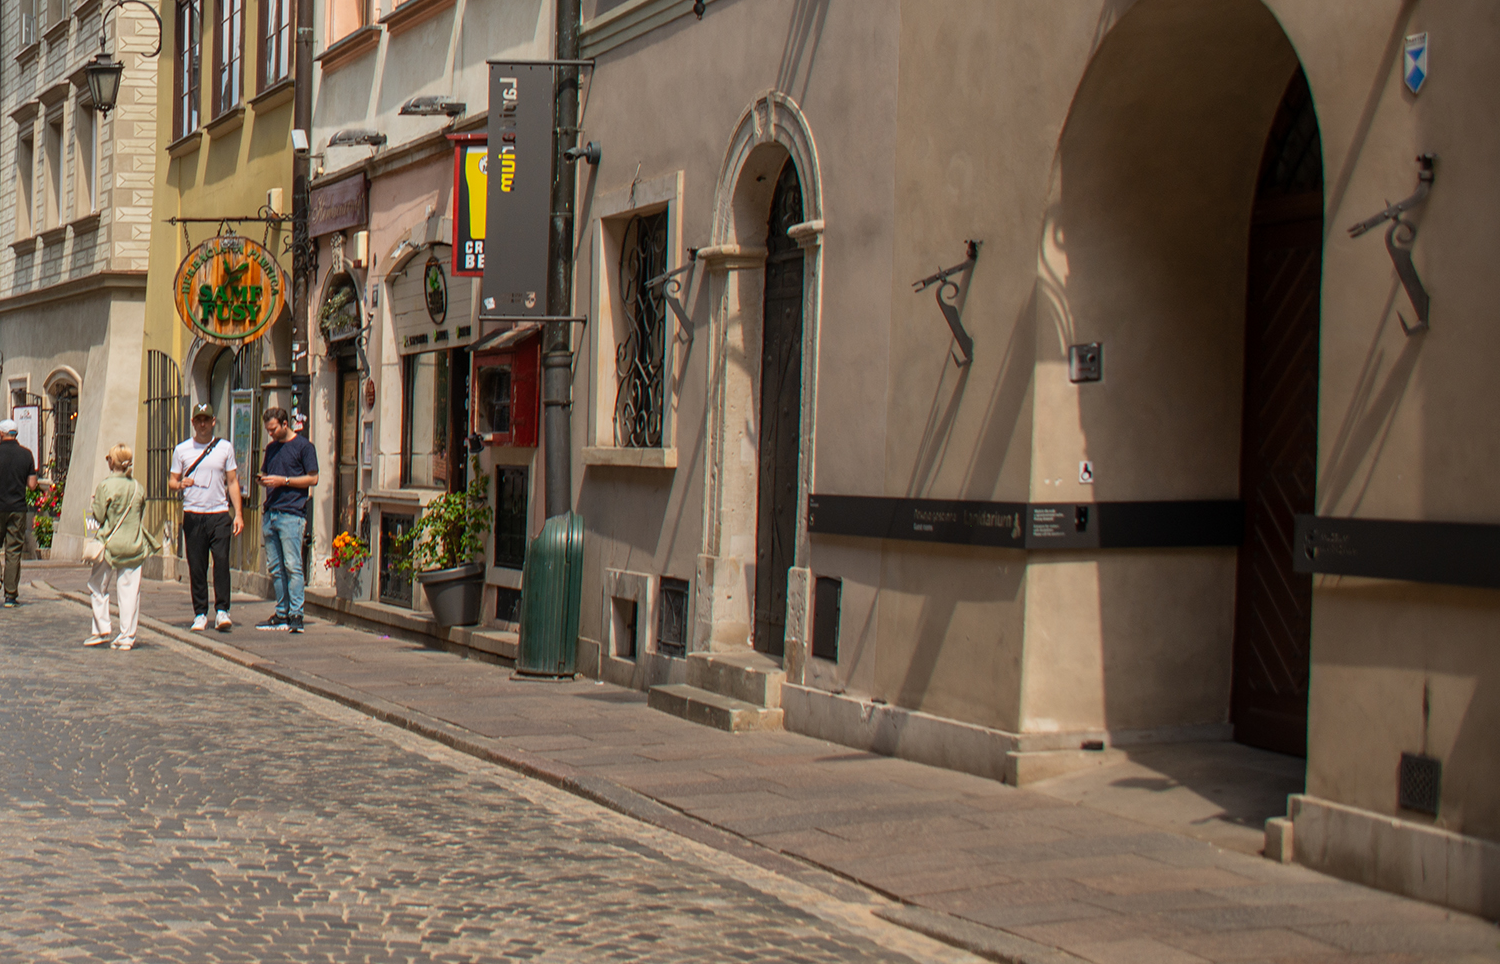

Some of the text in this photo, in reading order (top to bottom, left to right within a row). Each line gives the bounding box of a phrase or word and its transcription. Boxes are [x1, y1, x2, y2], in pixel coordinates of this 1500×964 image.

[247, 248, 280, 296] PIWNICA
[201, 301, 262, 321] FUSY
[963, 509, 1013, 528] Lapidarium
